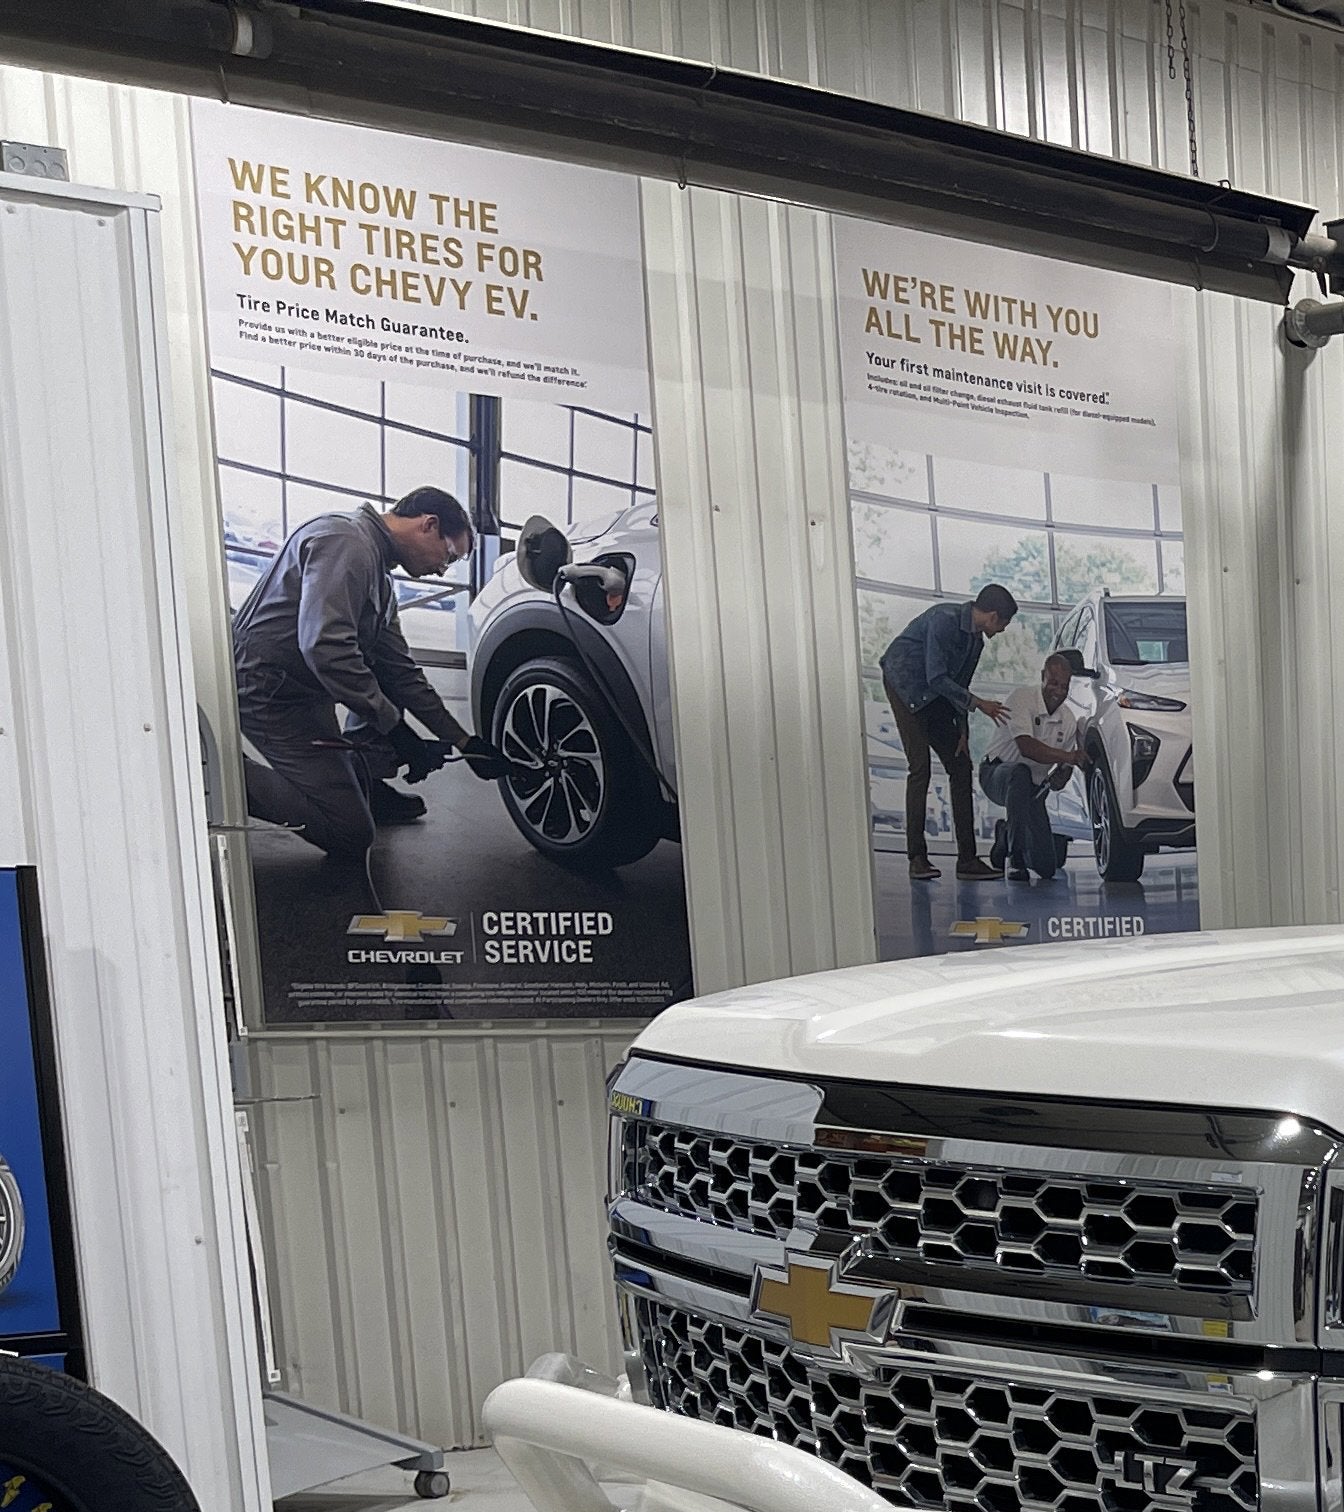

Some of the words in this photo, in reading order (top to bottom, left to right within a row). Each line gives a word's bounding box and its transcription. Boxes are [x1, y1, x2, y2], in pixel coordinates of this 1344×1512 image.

[228, 157, 291, 199] WE
[304, 172, 417, 220] KNOW
[429, 193, 498, 234] THE
[232, 200, 346, 249] RIGHT
[358, 222, 463, 269] TIRES
[477, 241, 543, 281] FOR
[232, 242, 337, 290] YOUR
[350, 263, 473, 310] CHEVY
[485, 283, 538, 321] EV.
[861, 268, 956, 314] WE'RE
[964, 289, 1037, 329] WITH
[1046, 304, 1099, 339] YOU
[236, 293, 271, 312] Tire
[276, 300, 320, 321] Price
[325, 308, 376, 330] Match
[381, 317, 470, 344] Guarantee.
[865, 306, 921, 344] ALL
[928, 318, 985, 356] THE
[992, 331, 1059, 369] WAY.
[238, 318, 273, 331] Provide
[275, 326, 285, 334] us
[288, 328, 307, 338] with
[317, 331, 345, 343] better
[347, 337, 378, 348] eligible
[380, 343, 401, 353] price
[416, 346, 430, 356] the
[432, 349, 450, 359] time
[453, 352, 461, 360] of
[464, 354, 504, 368] purchase,
[507, 360, 521, 369] and
[544, 364, 569, 375] match
[239, 331, 259, 341] Find
[268, 336, 297, 347] better
[299, 341, 322, 352] price
[324, 345, 351, 356] within
[354, 349, 365, 358] 30
[367, 351, 387, 362] days
[389, 354, 397, 363] of
[400, 356, 413, 365] the
[416, 358, 457, 372] purchase,
[460, 364, 474, 374] and
[498, 370, 525, 381] refund
[527, 374, 541, 383] the
[866, 351, 897, 369] Your
[900, 358, 929, 377] first
[932, 366, 1013, 391] maintenance
[1016, 380, 1042, 396] visit
[1045, 383, 1055, 398] is
[483, 911, 614, 935] CERTIFIED
[1048, 916, 1144, 938] CERTIFIED
[347, 950, 464, 964] CHEVROLET
[484, 940, 593, 964] SERVICE
[1114, 1450, 1198, 1498] LTZ
